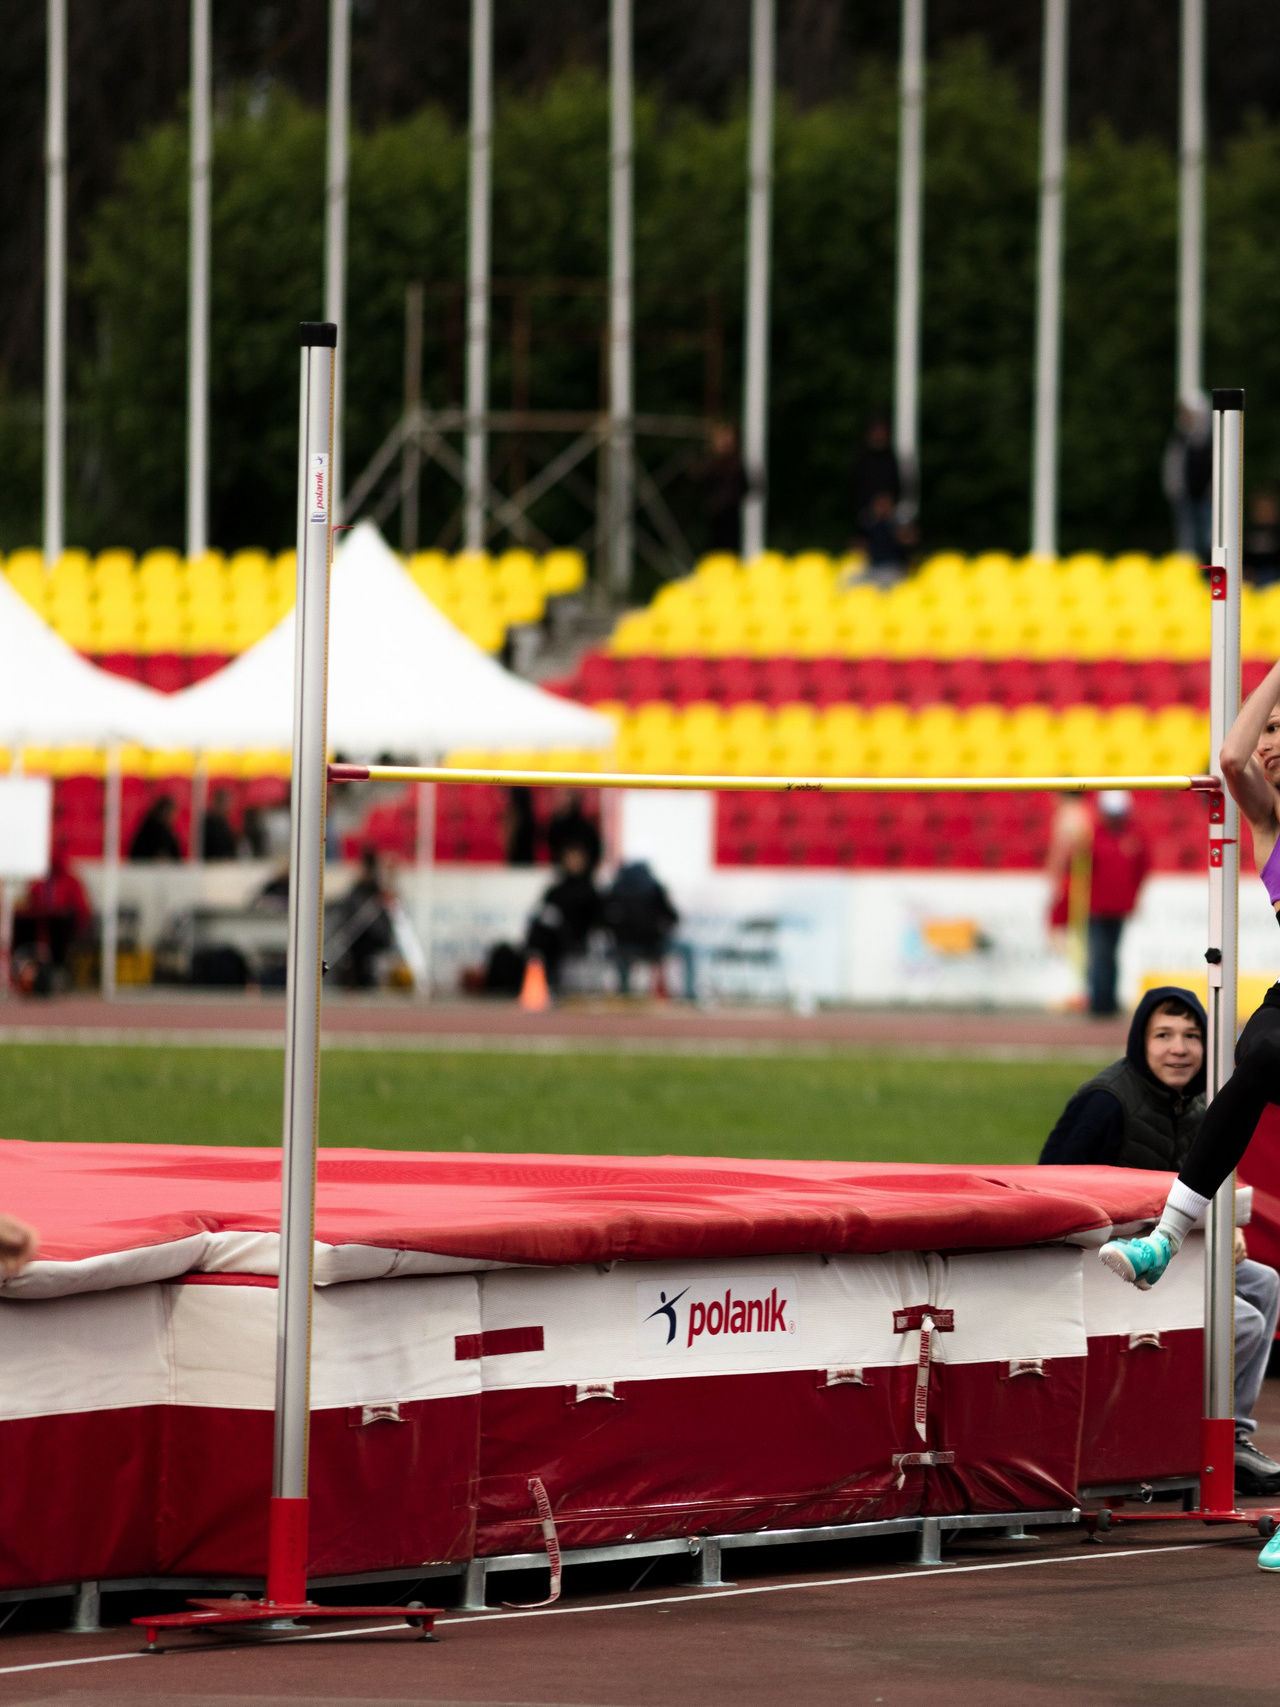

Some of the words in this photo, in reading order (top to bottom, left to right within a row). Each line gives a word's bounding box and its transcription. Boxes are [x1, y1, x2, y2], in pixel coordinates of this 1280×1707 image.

[315, 472, 325, 509] polanik
[687, 1287, 787, 1348] polanik
[919, 1330, 930, 1369] POLANIK
[916, 1385, 927, 1424] POLANIK
[546, 1538, 560, 1577] POLANIK
